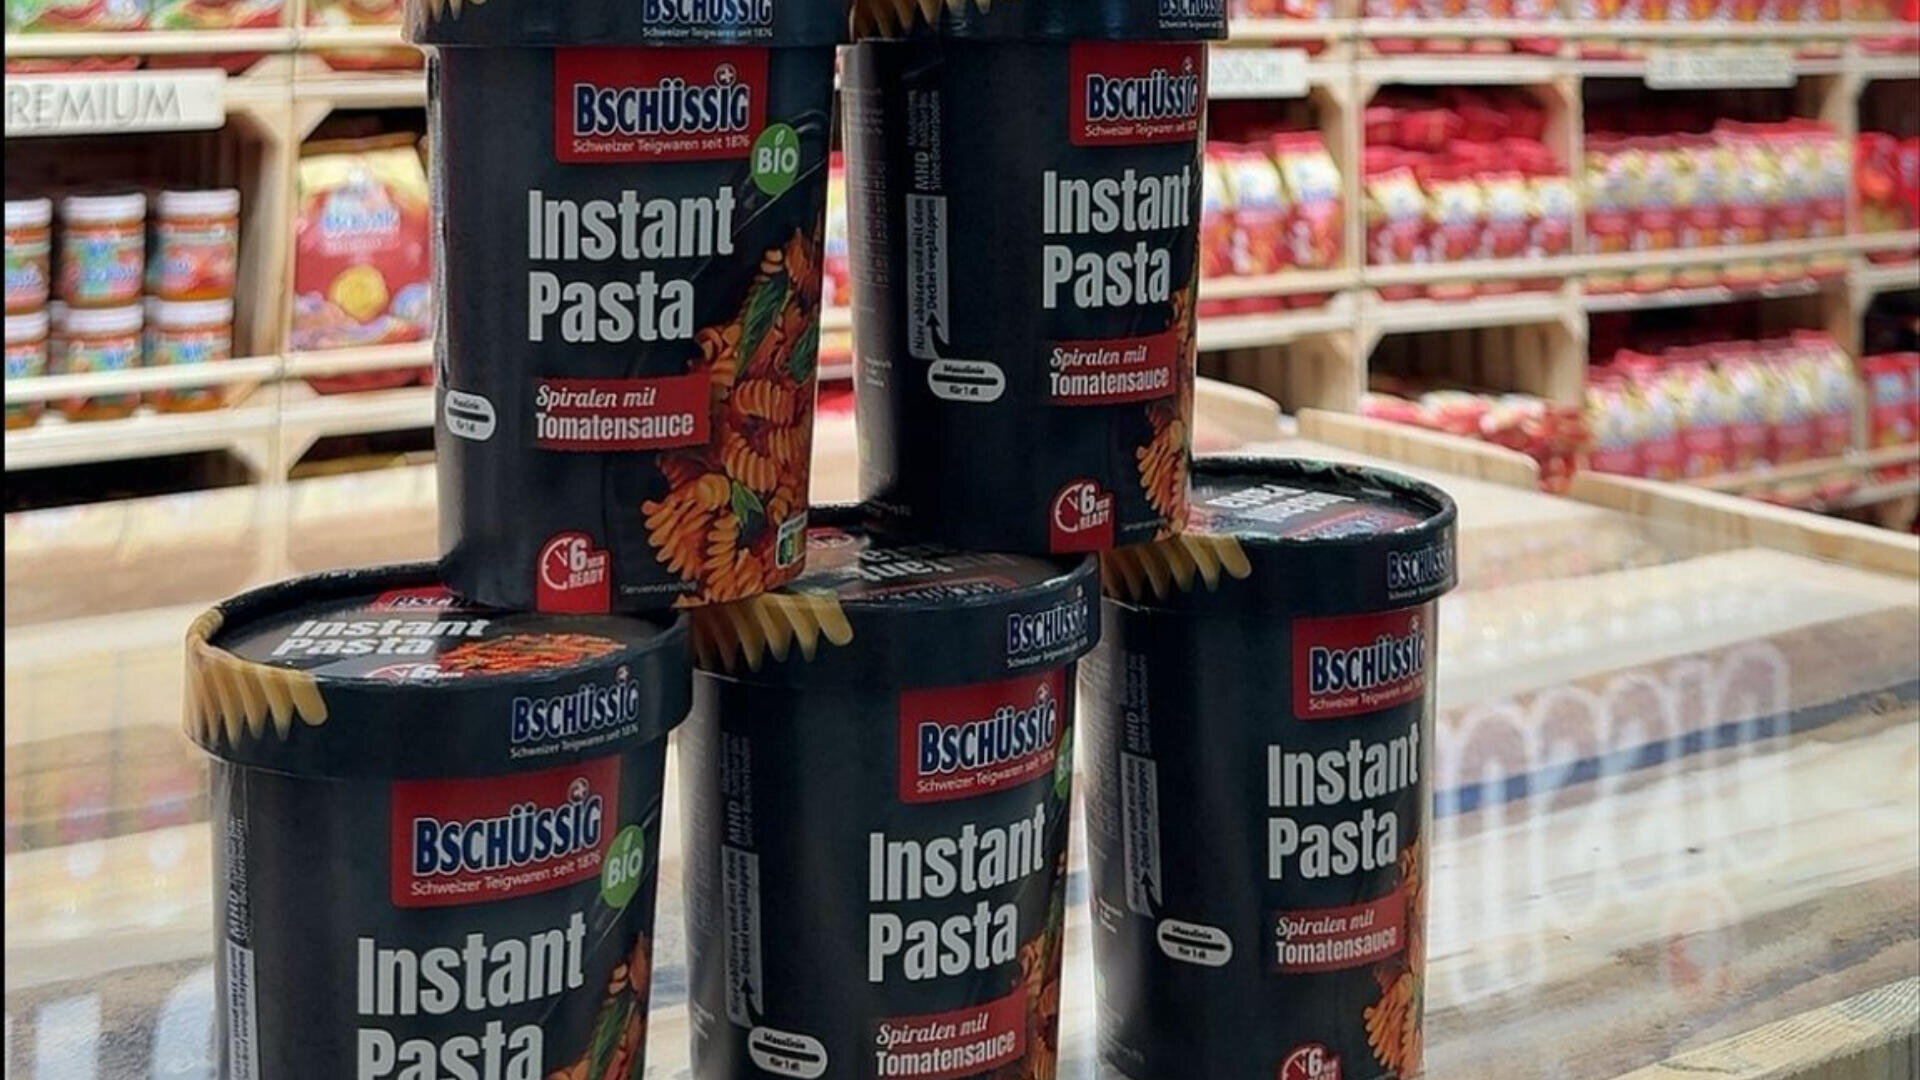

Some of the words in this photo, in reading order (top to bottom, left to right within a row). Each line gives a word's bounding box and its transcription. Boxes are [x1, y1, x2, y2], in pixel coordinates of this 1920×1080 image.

[573, 77, 750, 136] BSCHÜSSIG
[1086, 68, 1198, 122] BSCHÜSSIG
[573, 138, 635, 153] Schweizer
[638, 138, 699, 155] Teigwaren
[702, 136, 724, 148] seit
[725, 134, 750, 148] 1876
[756, 147, 798, 174] BIO
[915, 151, 930, 190] MHD
[1043, 165, 1191, 235] Instant
[528, 186, 736, 261] Instant
[1043, 242, 1171, 310] Pasta
[528, 270, 694, 343] Pasta
[1050, 347, 1120, 371] Spiralen
[1124, 346, 1148, 365] mit
[535, 385, 618, 411] Spiralen
[623, 387, 655, 408] mit
[1050, 365, 1169, 398] Tomatensauce
[536, 412, 694, 441] Tomatensauce
[1081, 484, 1095, 515] 6
[570, 538, 587, 572] 6
[271, 637, 435, 656] Pasta
[292, 618, 490, 637] Instant
[512, 680, 640, 743] BSCHÜSSIG
[918, 700, 1057, 775] BSCHÜSSIG
[916, 775, 974, 793] Schweizer
[1267, 722, 1419, 807] Instant
[413, 795, 602, 876] BSCHÜSSIG
[868, 803, 1045, 902] Instant
[1268, 810, 1398, 880] Pasta
[411, 877, 481, 896] Schweizer
[484, 869, 550, 891] Teigwaren
[552, 861, 575, 877] seit
[607, 848, 643, 888] BIO
[868, 900, 1018, 982] Pasta
[1275, 914, 1347, 938] Spiralen
[1349, 908, 1374, 930] mit
[357, 911, 588, 1016] Instant
[1275, 924, 1397, 965] Tomatensauce
[357, 1020, 544, 1080] Pasta
[876, 1022, 957, 1047] Spiralen
[960, 1013, 988, 1036] mit
[876, 1031, 1015, 1076] Tomatensauce
[1309, 1047, 1323, 1077] 6
